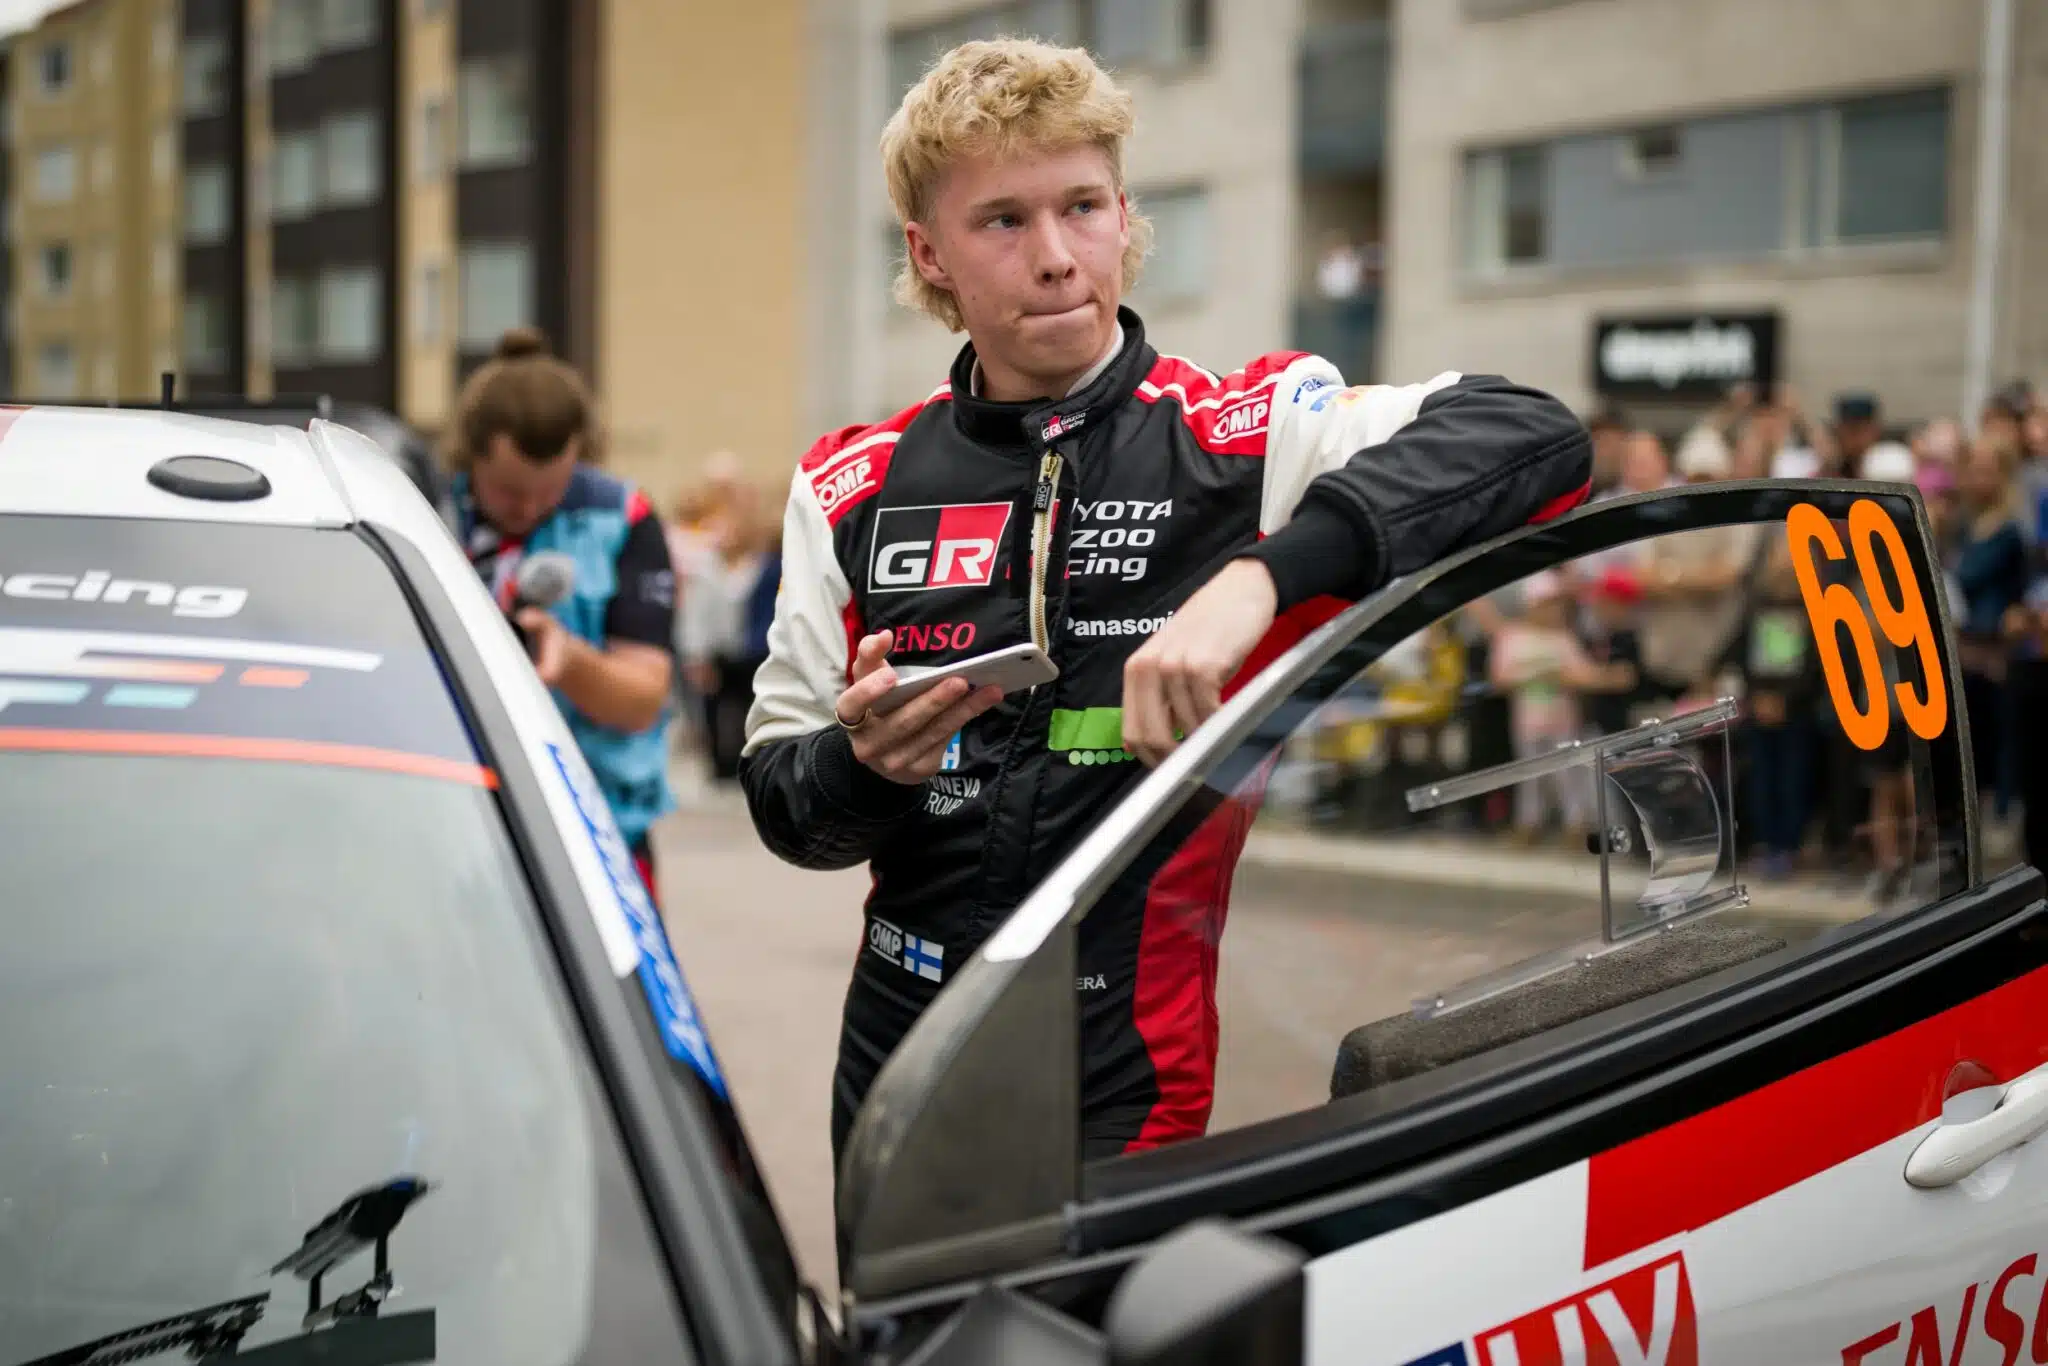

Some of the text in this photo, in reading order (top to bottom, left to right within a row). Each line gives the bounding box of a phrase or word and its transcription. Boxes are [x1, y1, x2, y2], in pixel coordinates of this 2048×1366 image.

[1042, 422, 1063, 441] GR
[1212, 401, 1268, 439] OMP
[818, 459, 872, 508] OMP
[1036, 485, 1047, 509] OMP
[1071, 498, 1173, 522] YOTA
[1069, 528, 1156, 550] ZOO
[874, 537, 995, 586] GR
[0, 568, 249, 618] cing
[875, 622, 977, 653] ENSO
[1786, 499, 1947, 750] 69
[869, 920, 902, 958] OMP
